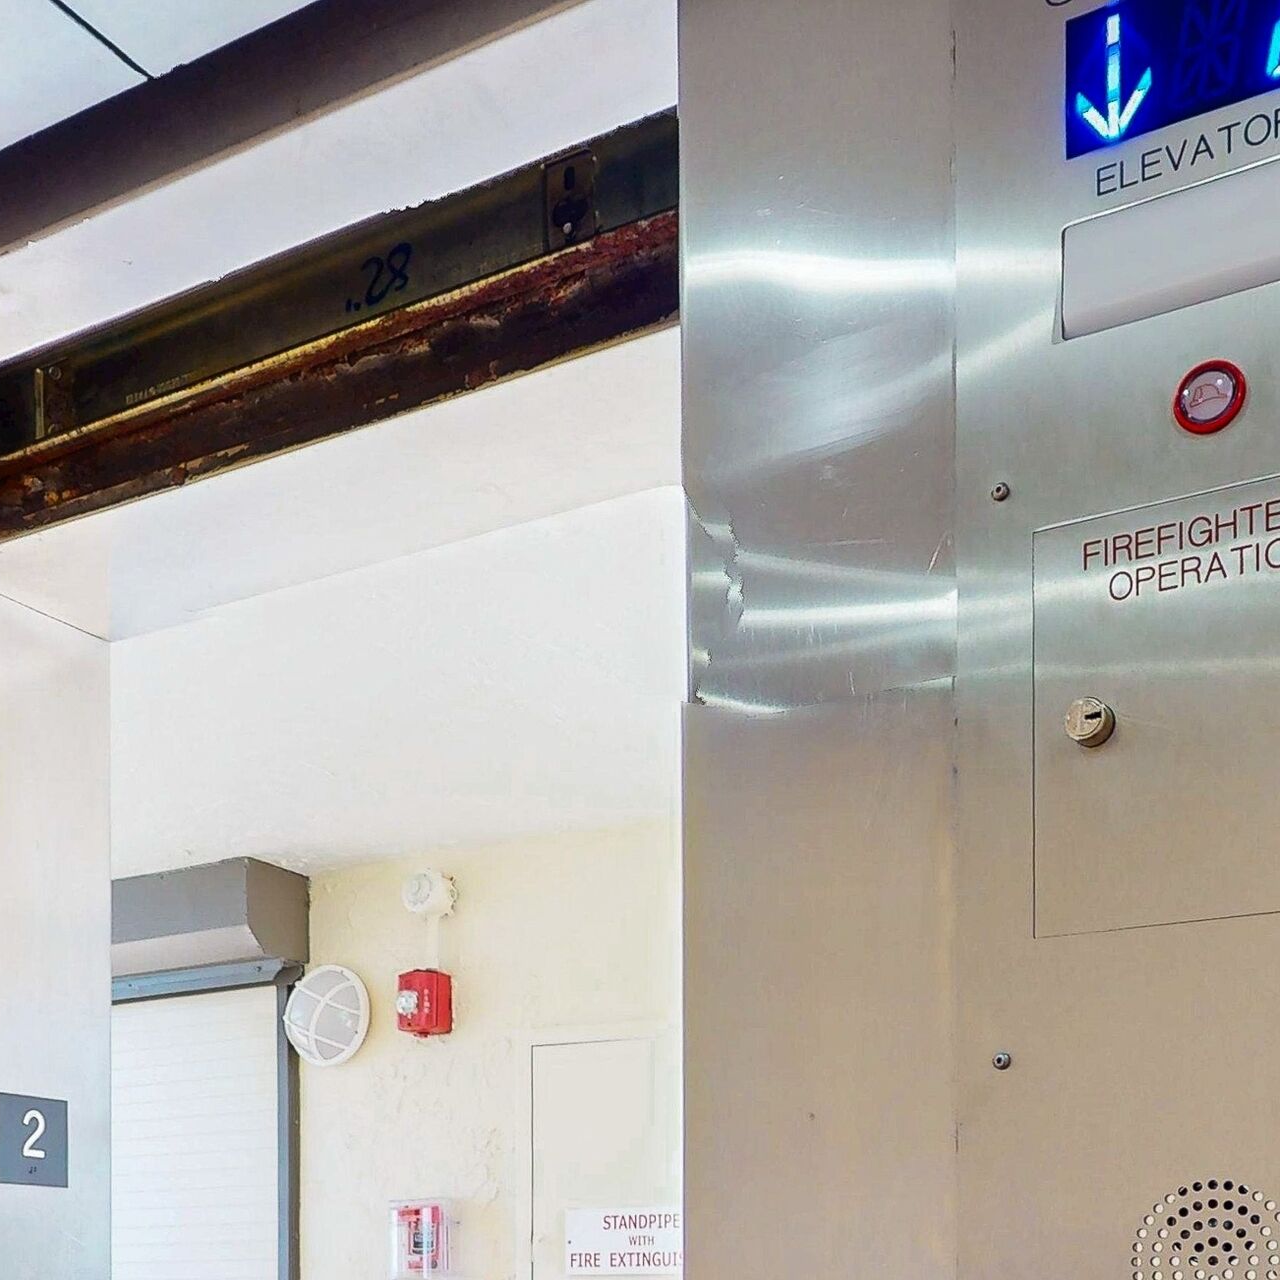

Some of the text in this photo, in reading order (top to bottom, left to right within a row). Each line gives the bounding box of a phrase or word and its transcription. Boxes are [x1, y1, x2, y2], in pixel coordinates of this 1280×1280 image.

[22, 1109, 47, 1159] 2
[602, 1213, 680, 1230] STANDPIPE
[629, 1235, 655, 1246] WITH
[570, 1252, 601, 1268] FIRE
